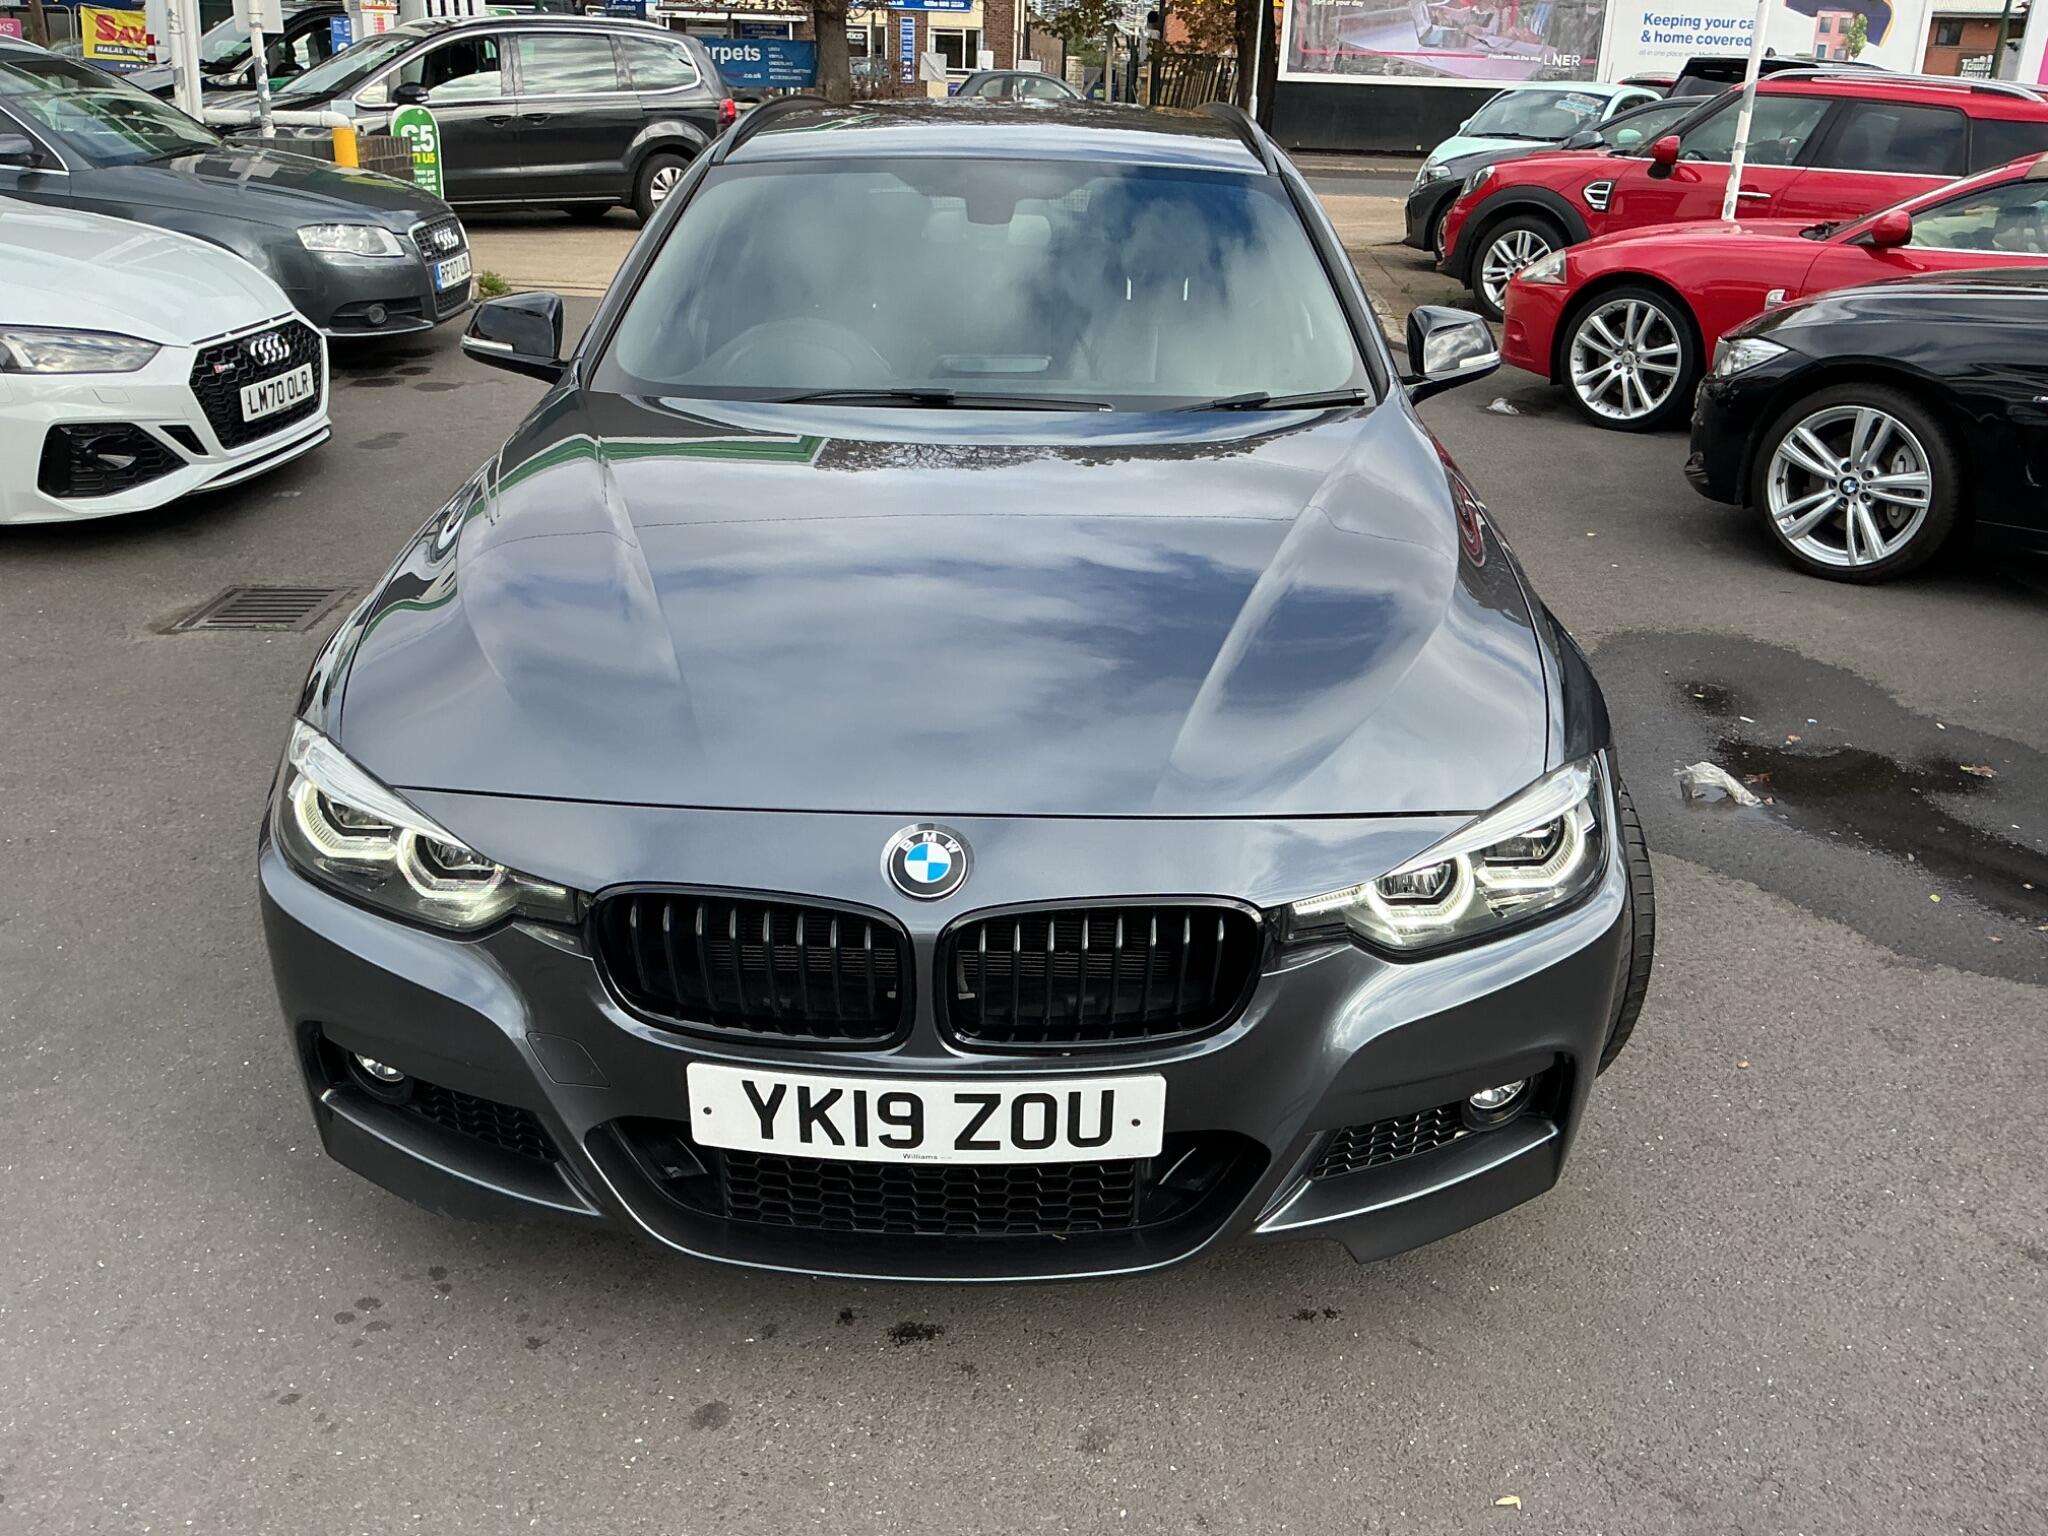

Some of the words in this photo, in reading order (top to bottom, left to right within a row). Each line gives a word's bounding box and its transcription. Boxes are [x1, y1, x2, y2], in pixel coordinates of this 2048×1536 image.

[1643, 13, 1702, 30] Keeping
[1705, 17, 1737, 30] your
[1641, 30, 1651, 42] &
[1654, 30, 1693, 43] home
[1544, 53, 1581, 67] LNER
[248, 381, 285, 414] LM70
[900, 832, 960, 853] BMW
[741, 1080, 924, 1149] YK19
[954, 1089, 1115, 1151] ZOU
